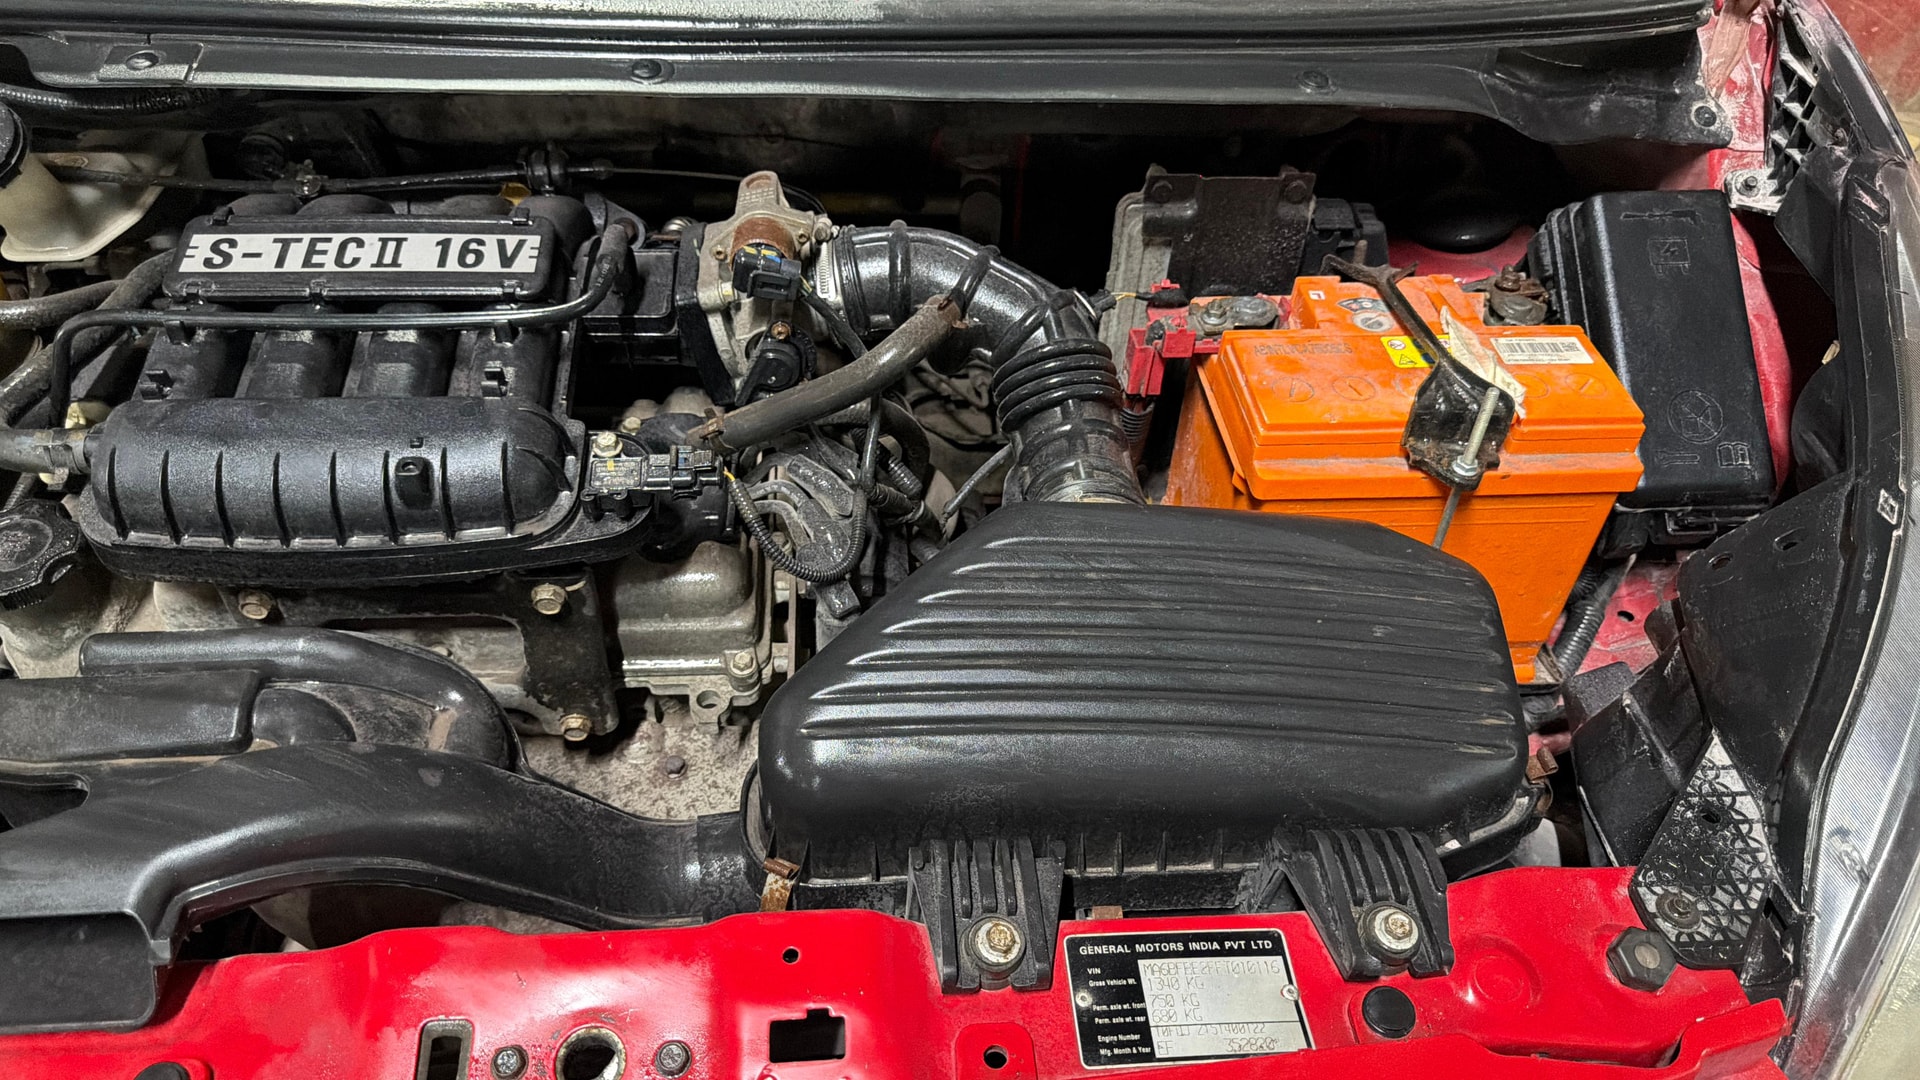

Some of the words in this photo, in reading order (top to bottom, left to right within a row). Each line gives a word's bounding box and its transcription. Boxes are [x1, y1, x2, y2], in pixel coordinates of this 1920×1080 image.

[434, 237, 527, 269] 16V
[1079, 944, 1131, 956] GENERAL
[1136, 942, 1184, 953] MOTORS
[1188, 941, 1220, 951] INDIA
[1225, 940, 1246, 950] PVT
[1251, 940, 1273, 949] LTD
[1148, 976, 1180, 991] 1340
[1186, 976, 1204, 990] KG
[1093, 1004, 1109, 1012] Perm.
[1149, 994, 1175, 1008] 750
[1181, 993, 1200, 1007] KG
[1152, 1009, 1178, 1023] 680
[1184, 1008, 1203, 1022] KG
[1098, 1035, 1118, 1043] Engine
